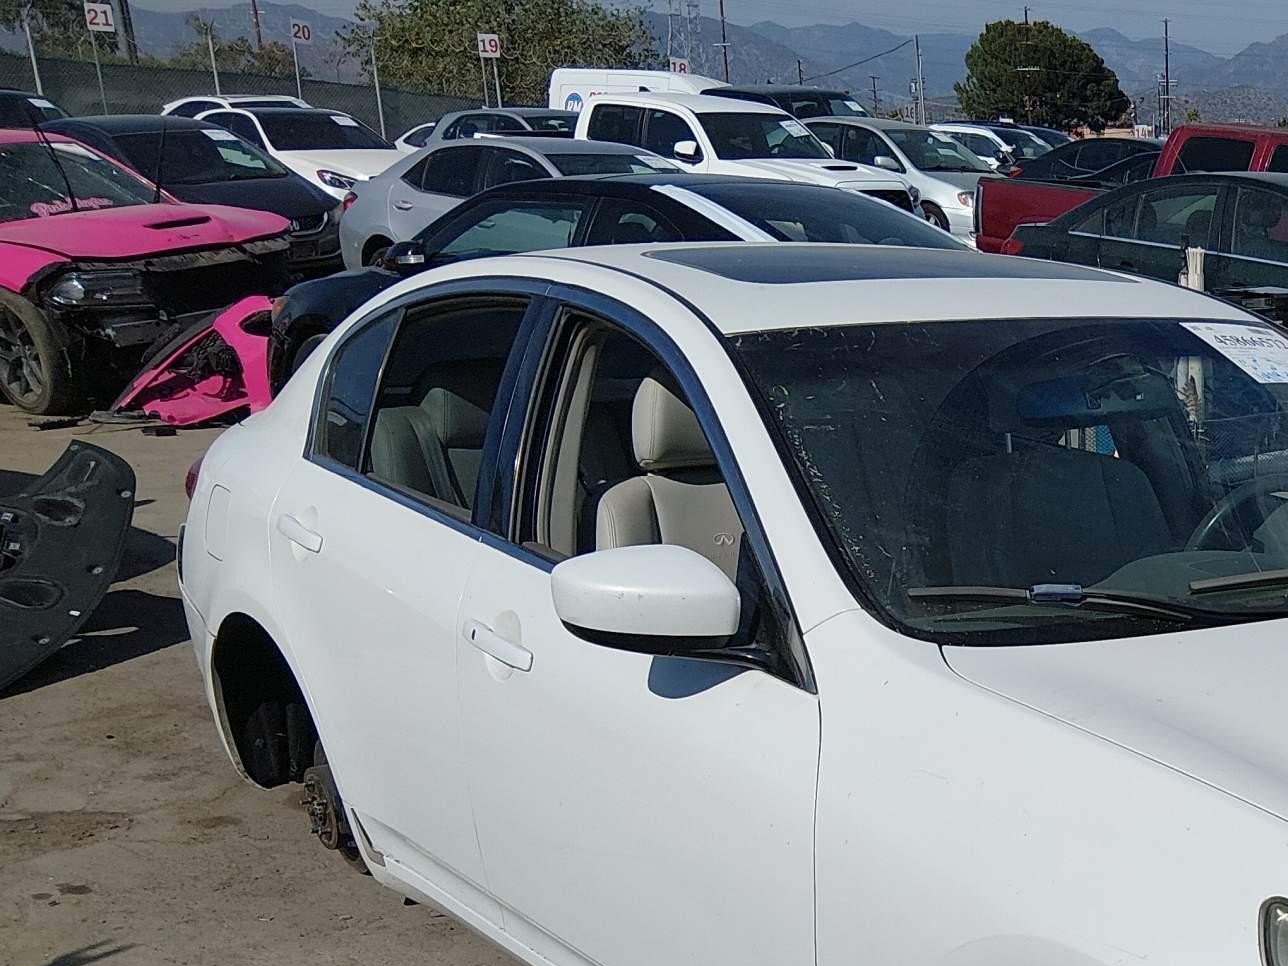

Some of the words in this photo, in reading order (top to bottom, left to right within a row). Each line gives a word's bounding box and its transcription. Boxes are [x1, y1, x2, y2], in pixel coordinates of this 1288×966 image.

[87, 9, 112, 27] 21
[292, 23, 310, 40] 20
[479, 38, 498, 53] 19
